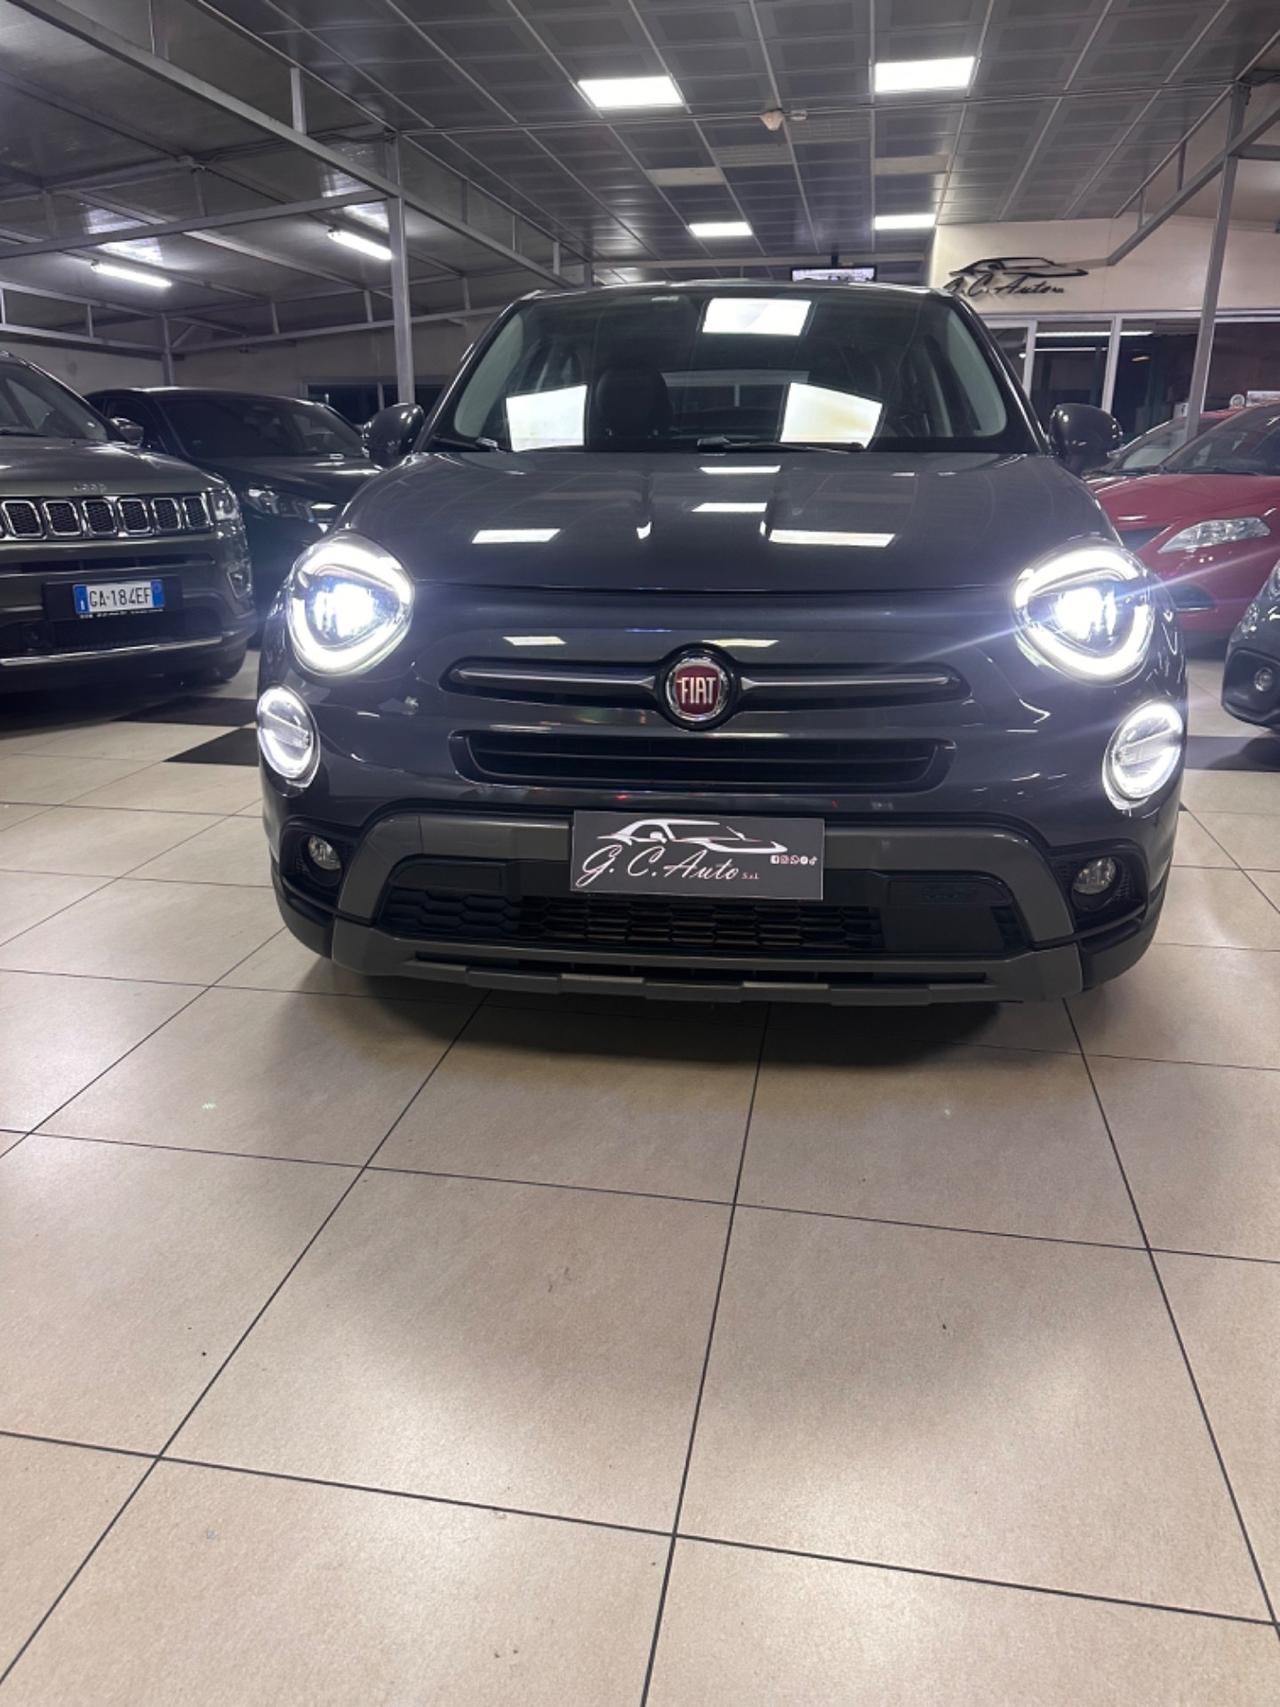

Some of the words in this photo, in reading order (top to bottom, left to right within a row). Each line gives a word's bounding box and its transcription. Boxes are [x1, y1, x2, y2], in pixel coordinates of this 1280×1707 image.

[995, 274, 1051, 294] Auto
[681, 677, 717, 704] FIAT
[627, 846, 666, 877] C.
[663, 849, 739, 880] Auto
